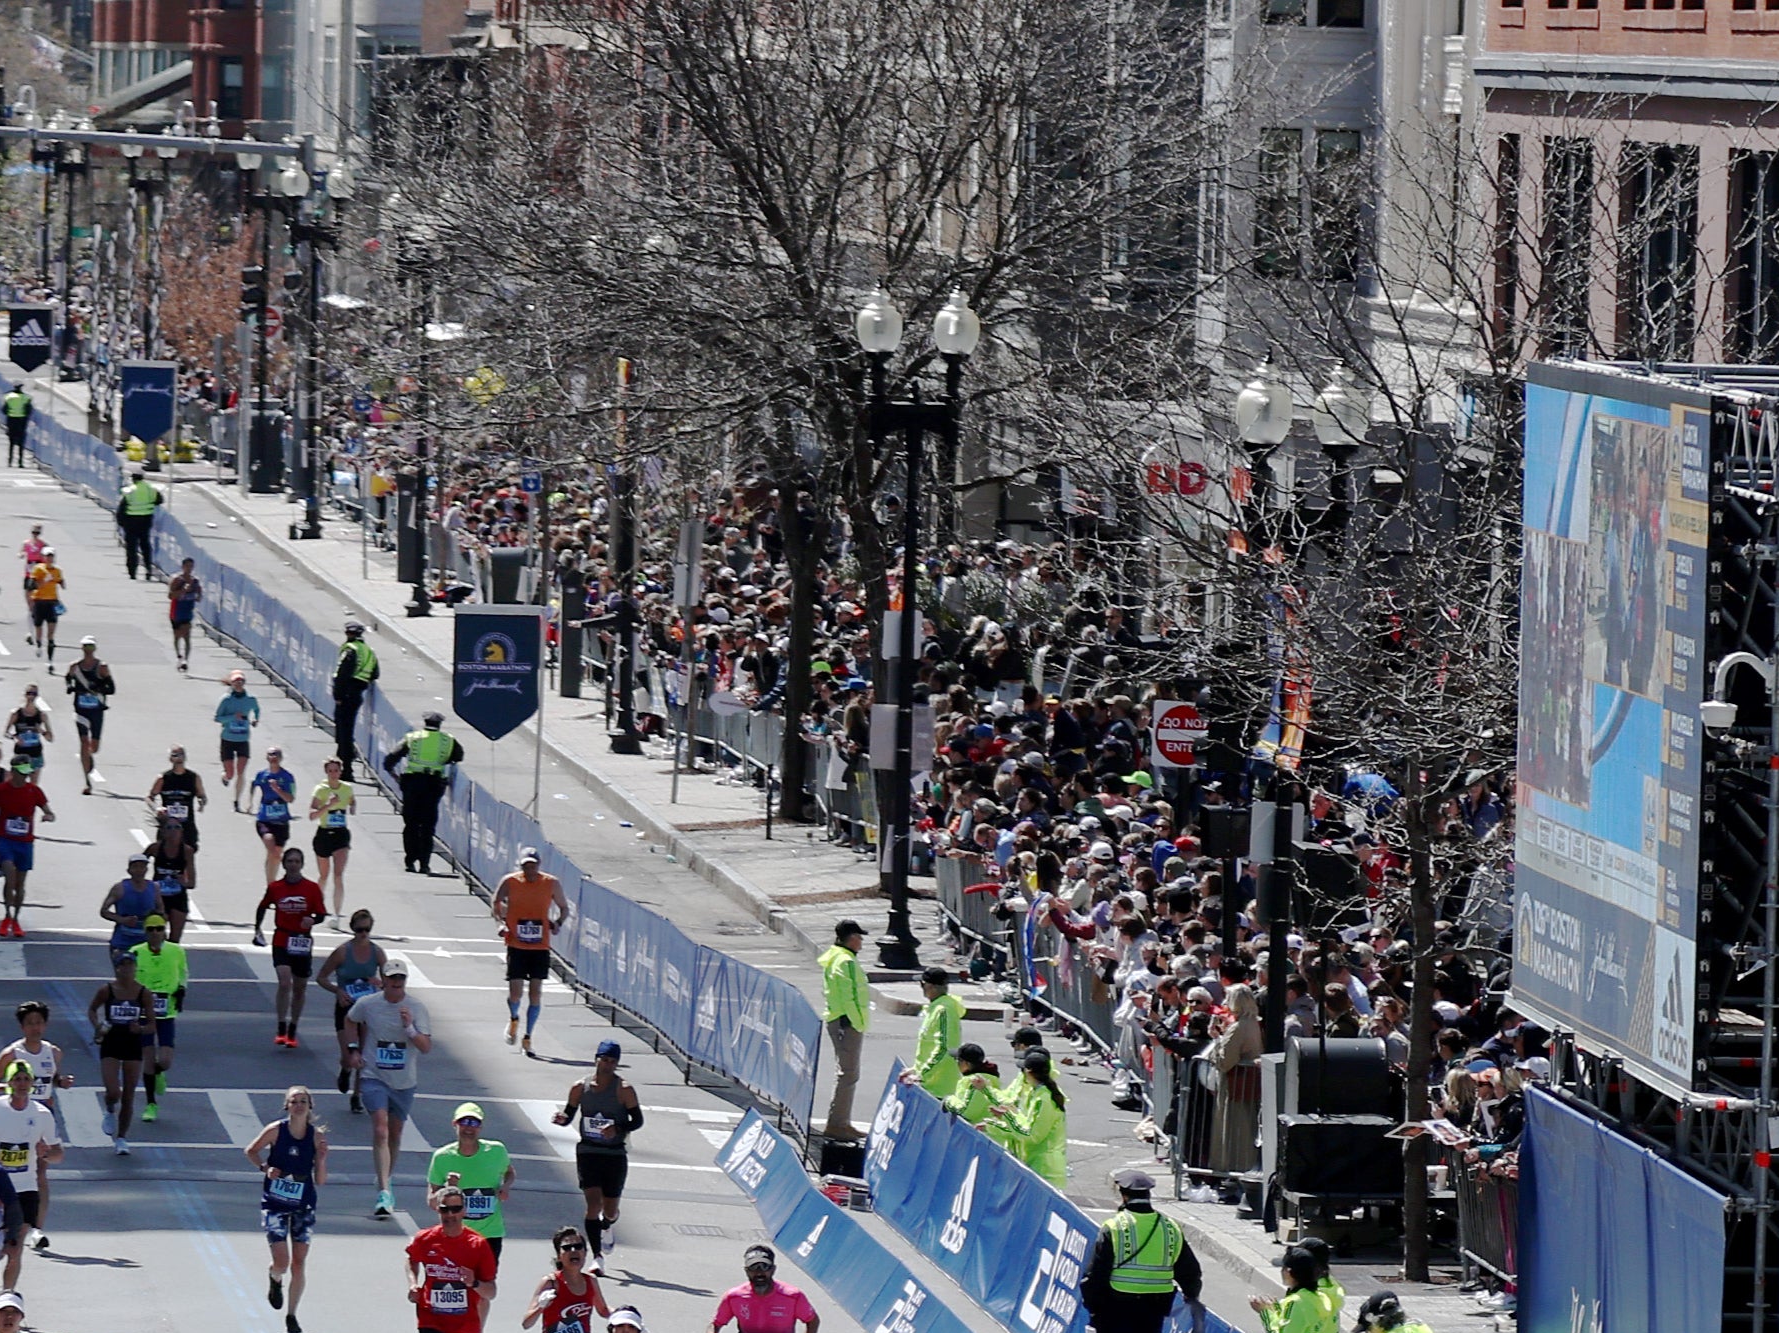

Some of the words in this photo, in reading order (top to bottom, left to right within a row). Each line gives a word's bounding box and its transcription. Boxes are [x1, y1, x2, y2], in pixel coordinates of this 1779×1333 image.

[1163, 717, 1181, 730] DO
[1165, 741, 1197, 754] ENTE
[1532, 939, 1579, 995] MARATHON
[434, 1290, 465, 1304] 13095
